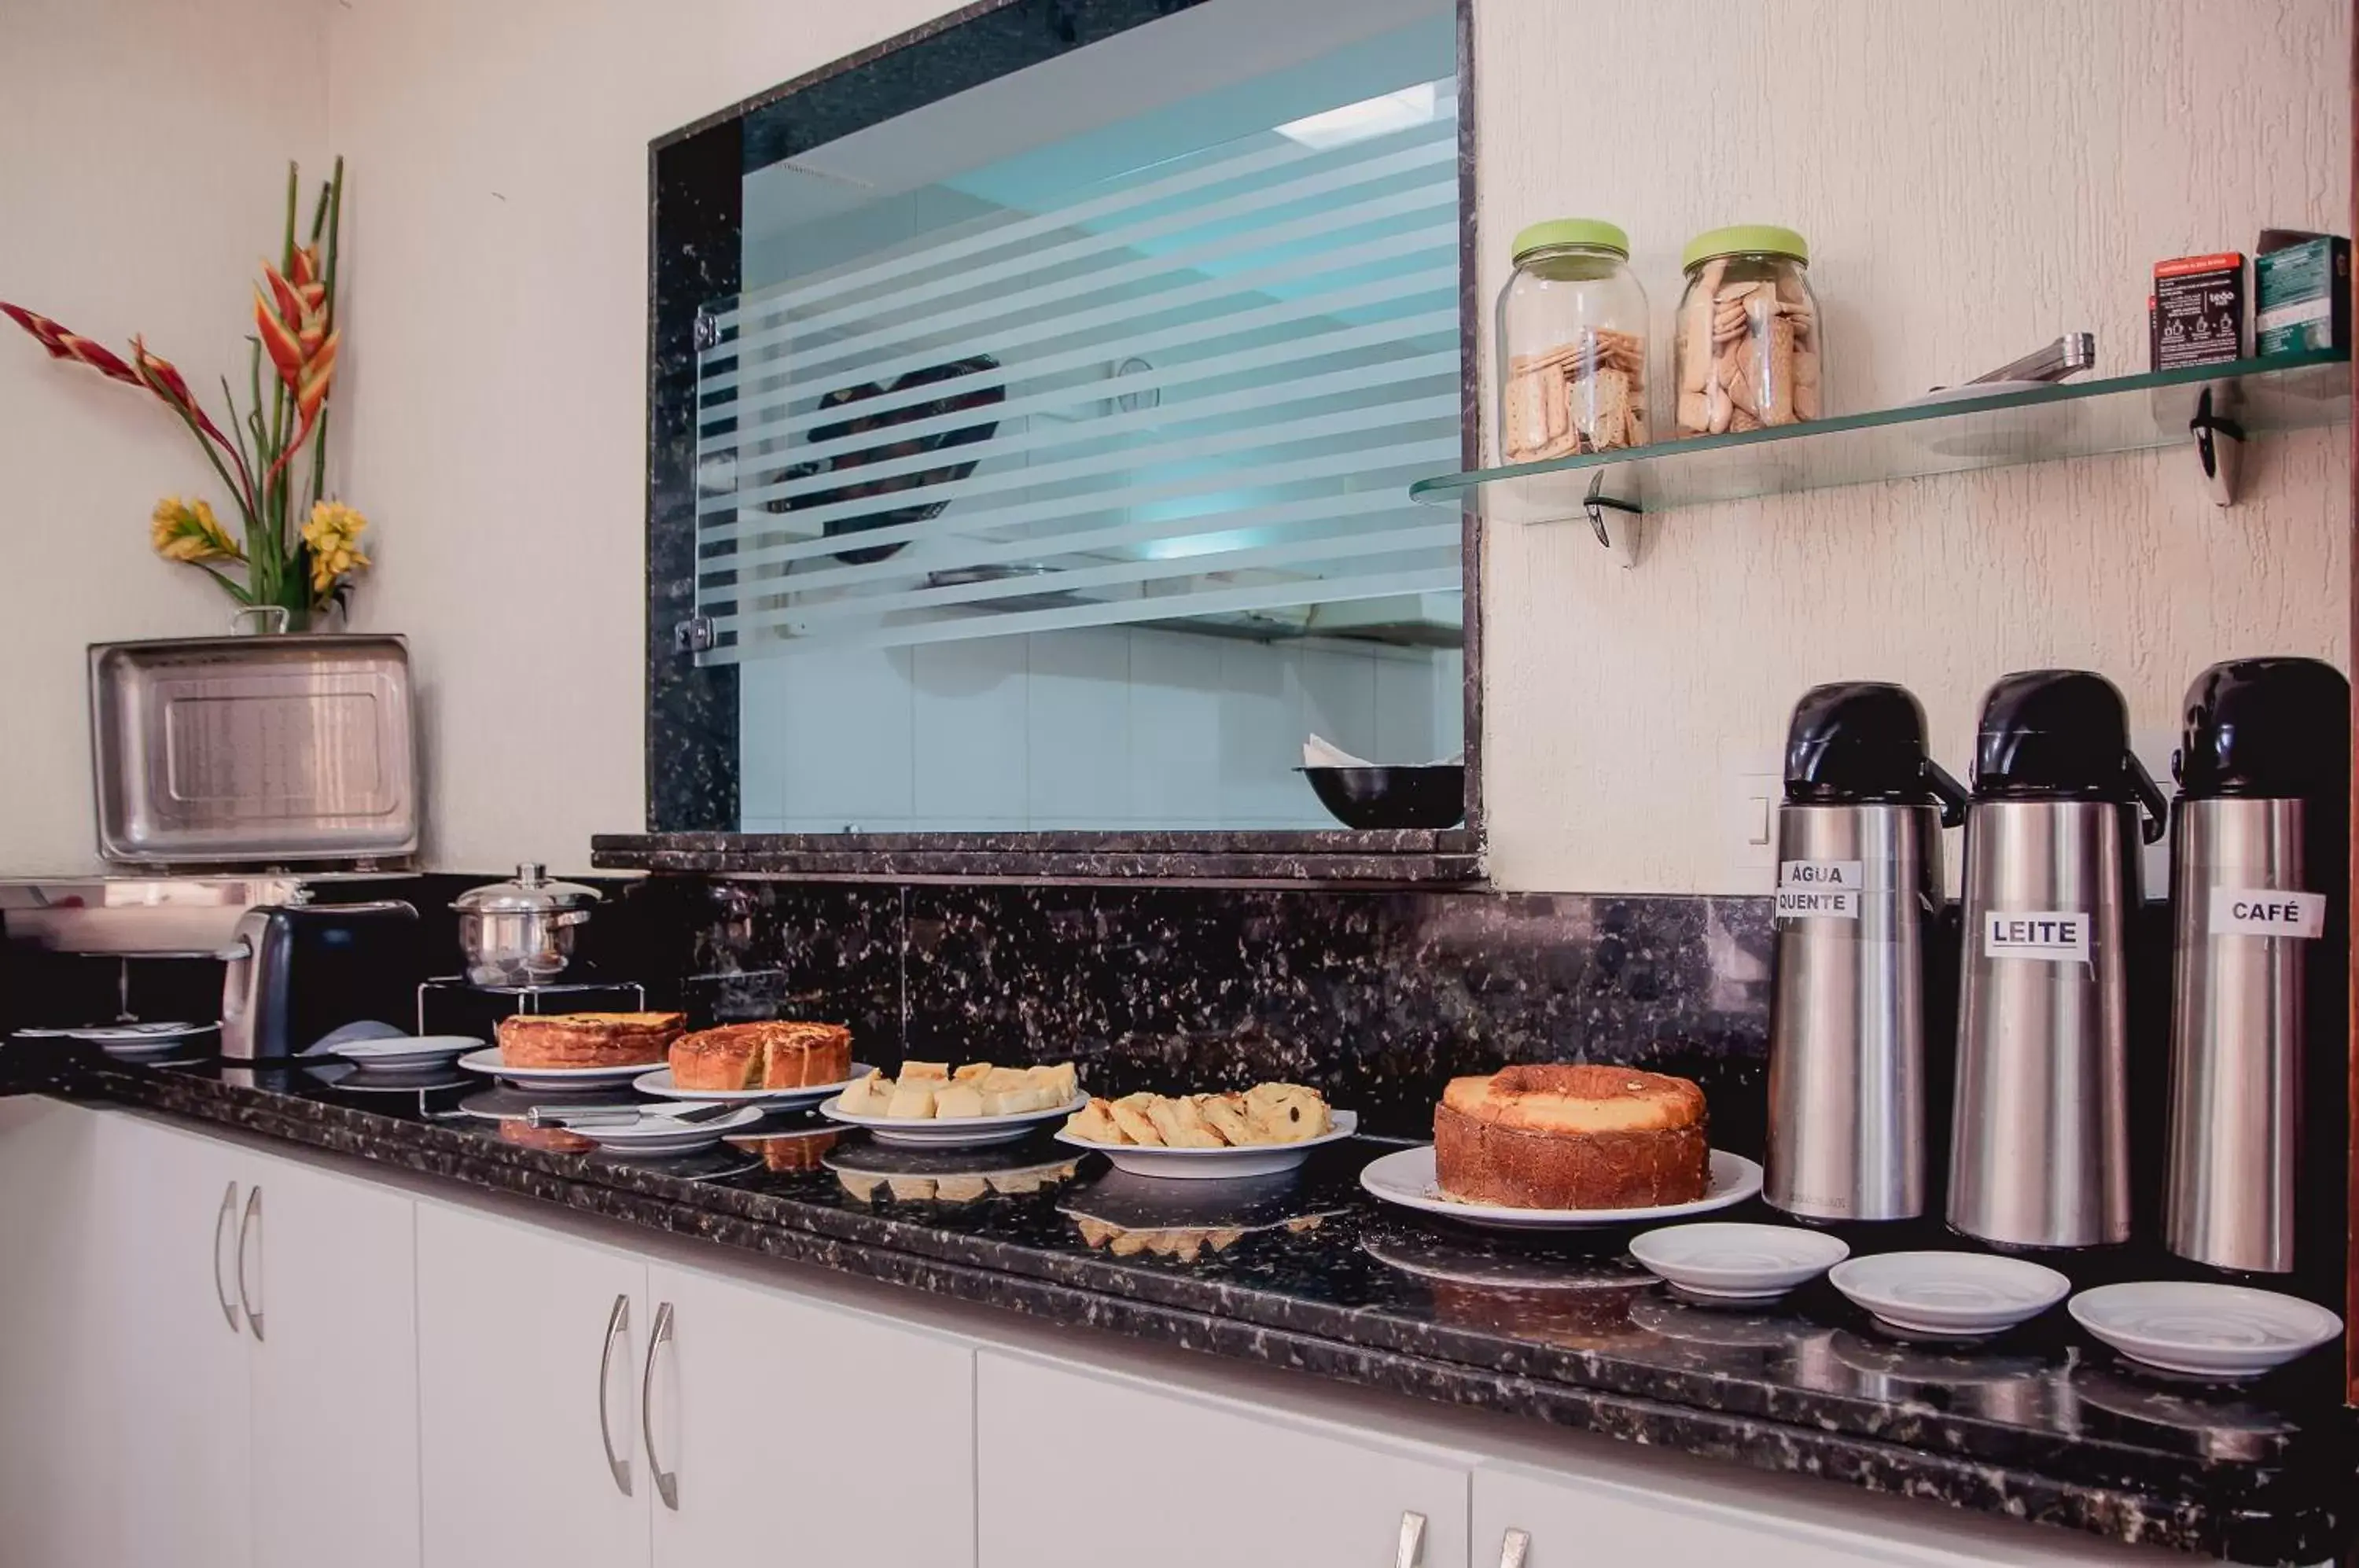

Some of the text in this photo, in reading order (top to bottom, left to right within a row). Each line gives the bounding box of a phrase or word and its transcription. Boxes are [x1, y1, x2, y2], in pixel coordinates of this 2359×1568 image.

[1792, 863, 1842, 883] ÁGUA
[1779, 894, 1846, 911] QUENTE
[2232, 900, 2299, 922] CAFÉ
[1994, 921, 2076, 943] LEITE
